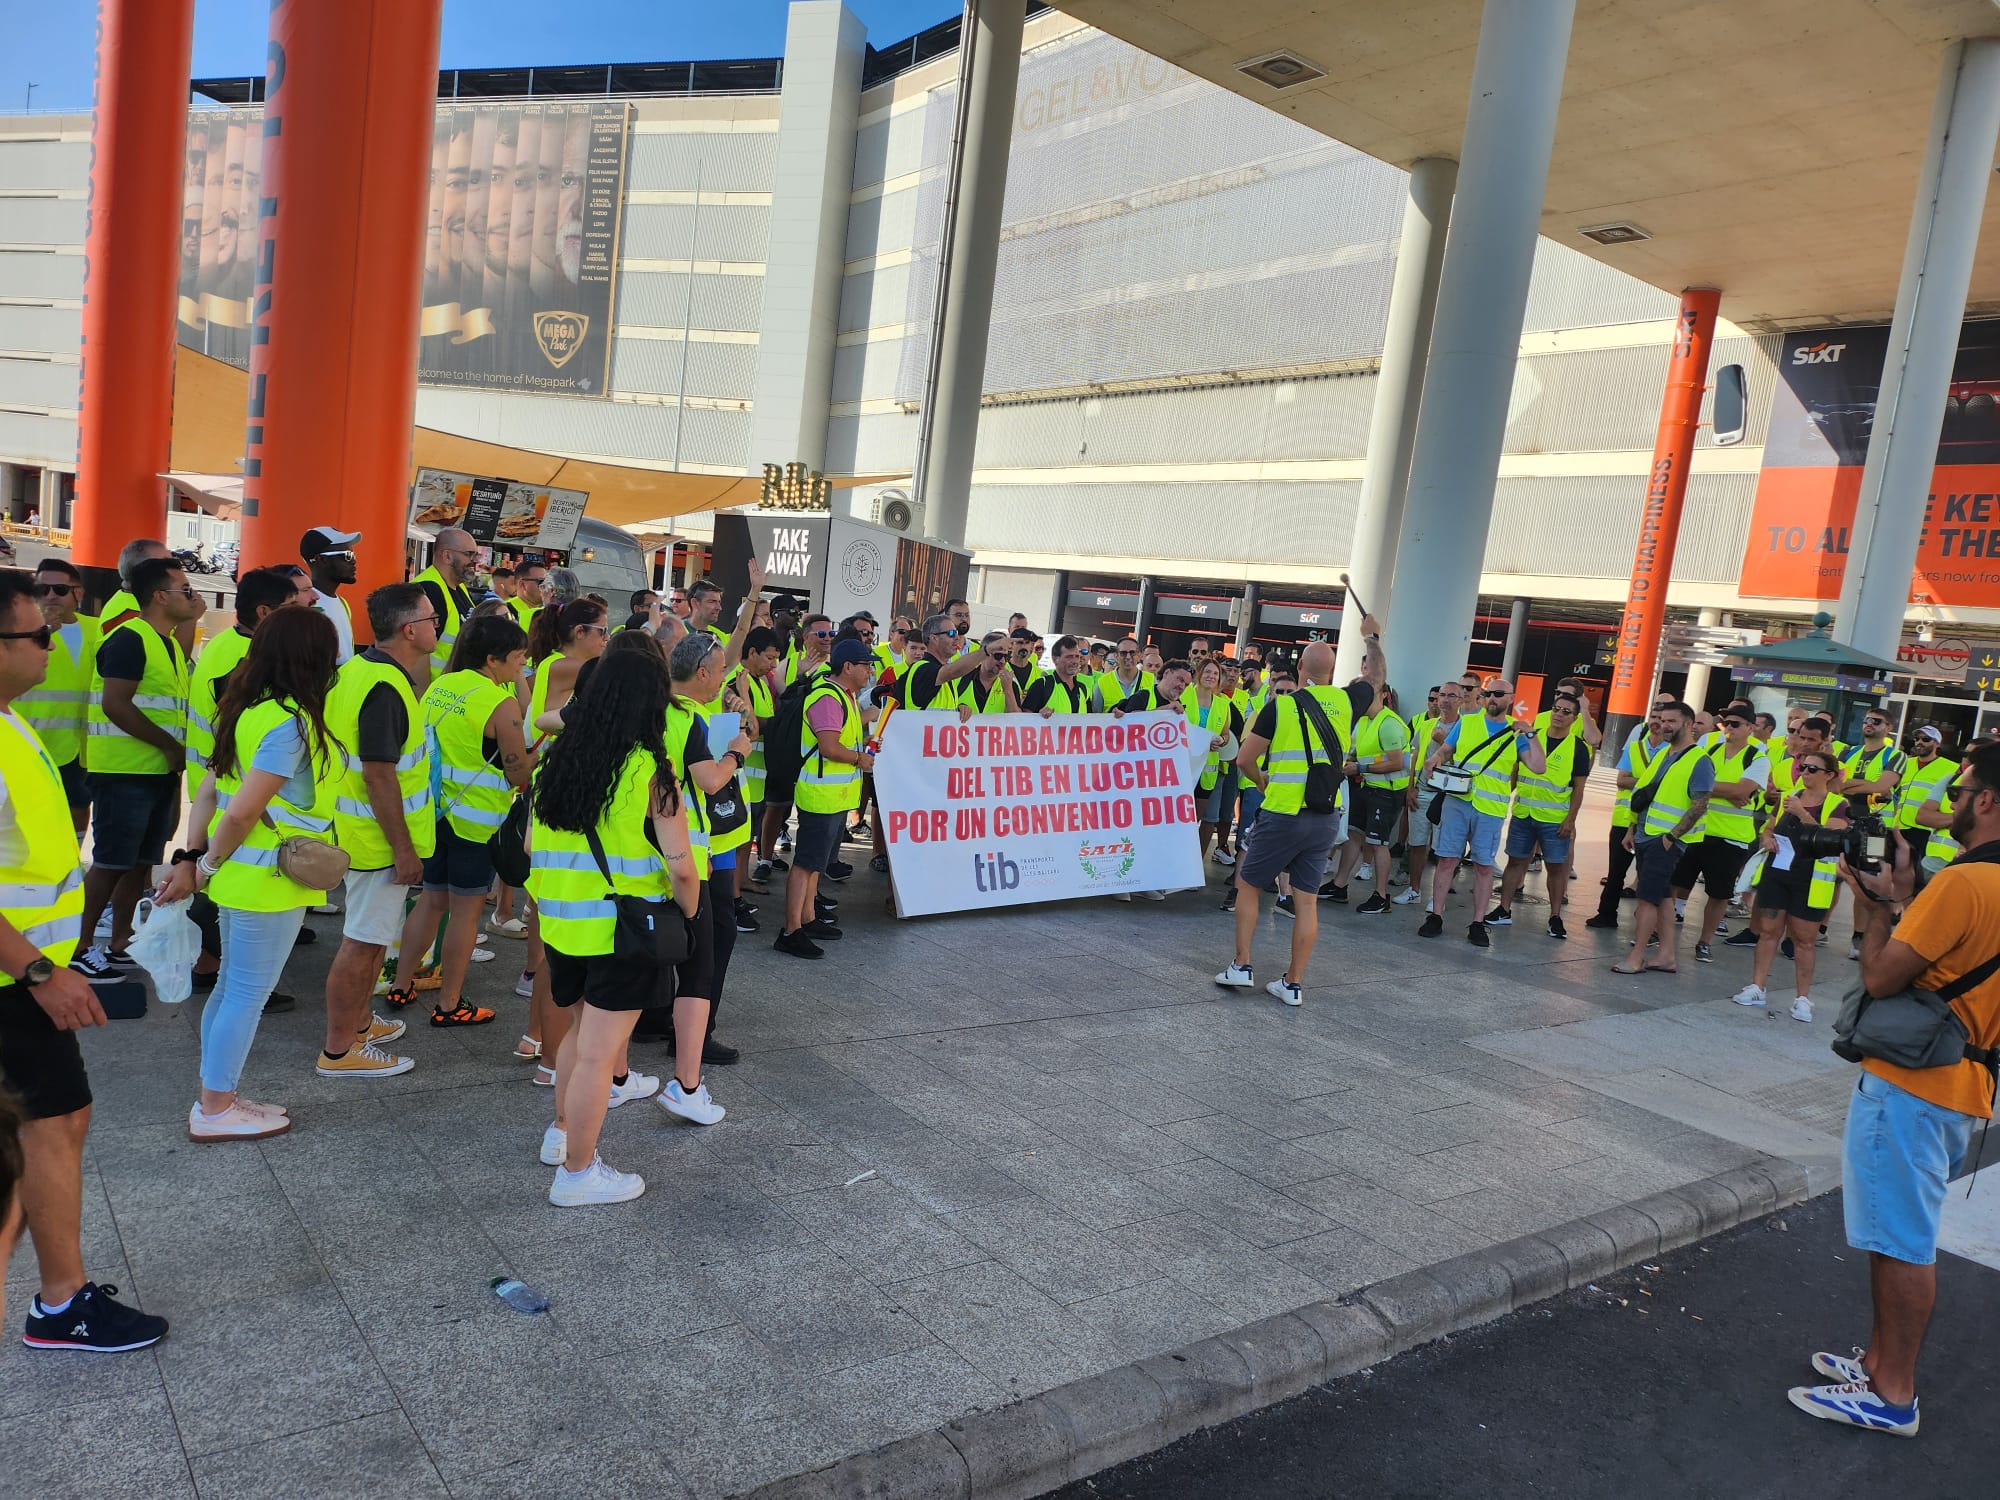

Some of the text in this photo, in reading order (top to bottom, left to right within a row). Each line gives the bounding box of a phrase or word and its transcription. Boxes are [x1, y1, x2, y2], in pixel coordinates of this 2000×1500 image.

[543, 323, 575, 339] MEGA
[1674, 307, 1699, 359] SIXT
[550, 338, 568, 351] Park
[1792, 342, 1846, 365] SIXT
[418, 368, 576, 389] elcome to the home of Megapark
[1943, 494, 2000, 522] KE
[773, 528, 809, 551] TAKE
[1767, 526, 1850, 554] TO AL
[860, 543, 880, 560] NATURAL
[765, 554, 812, 577] AWAY
[1615, 452, 1674, 688] THE KEY TO HAPPINESS.
[1812, 565, 2000, 584] Rent ars now fro
[1096, 595, 1111, 606] SIXT
[1190, 603, 1207, 614] SIXT
[1300, 611, 1320, 624] SIXT
[922, 723, 970, 758] LOS
[947, 757, 1180, 799] DEL TIB EN LUCHA
[889, 809, 948, 844] POR
[955, 807, 985, 841] UN
[993, 798, 1133, 838] CONVENIO
[1077, 842, 1133, 857] SATI
[974, 850, 1020, 893] tib
